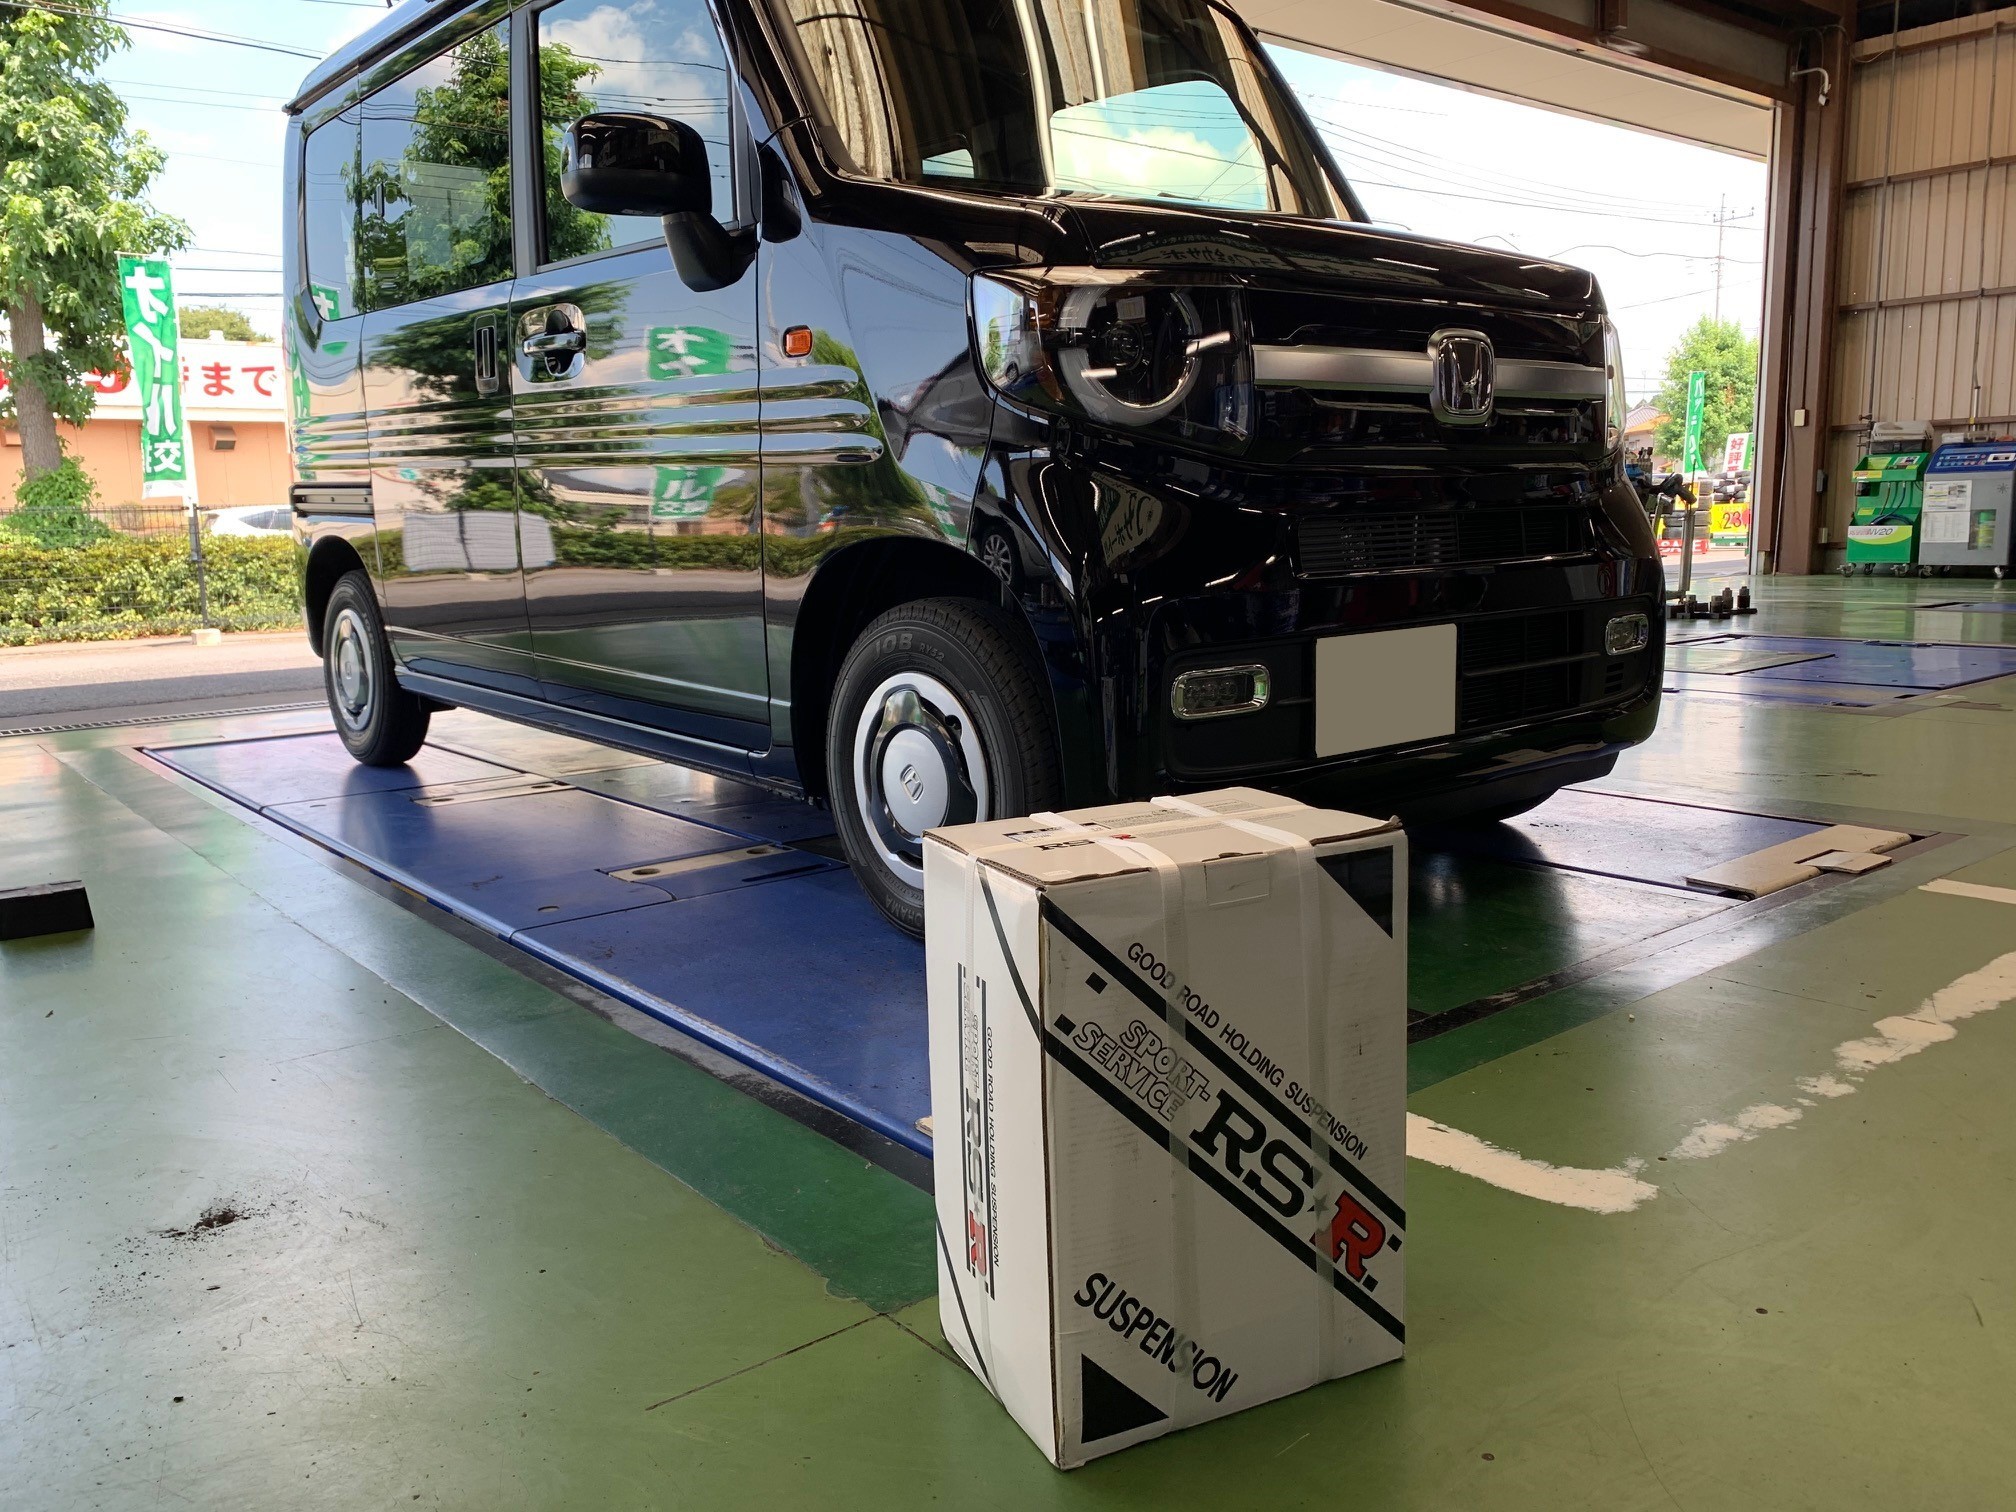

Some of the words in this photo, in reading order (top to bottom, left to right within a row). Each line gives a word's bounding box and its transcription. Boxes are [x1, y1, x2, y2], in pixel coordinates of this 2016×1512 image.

[180, 357, 278, 397] まで
[1659, 539, 1702, 553] SAE
[986, 1026, 994, 1069] GOOD
[1072, 1021, 1186, 1123] SERVICE
[1128, 942, 1176, 990] GOOD
[1176, 984, 1220, 1029] ROAD
[1219, 1023, 1285, 1088] HOLDING
[1284, 1081, 1369, 1161] SUSPENSION
[987, 1073, 995, 1112] ROAD
[988, 1116, 997, 1179] HOLDING
[990, 1182, 1000, 1268] SUSPENSION
[1073, 1272, 1239, 1403] SUSPENSION
